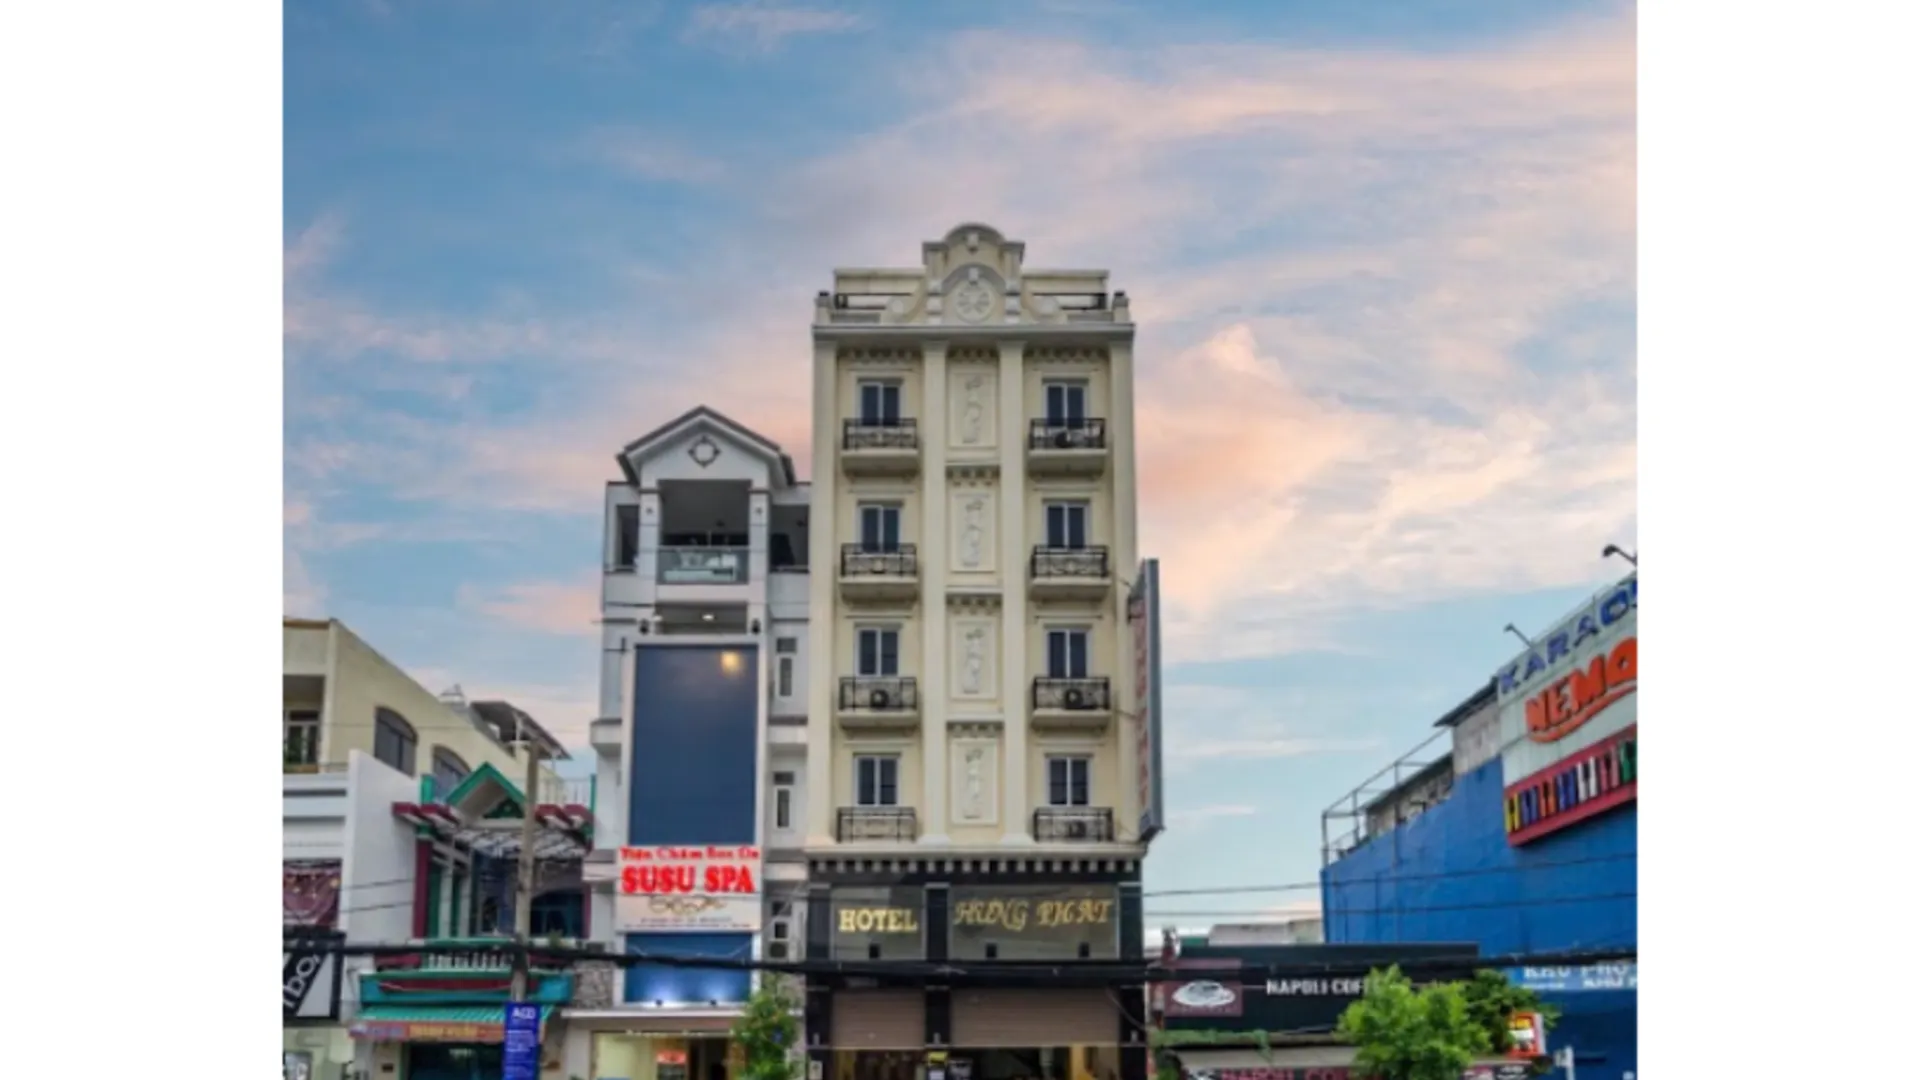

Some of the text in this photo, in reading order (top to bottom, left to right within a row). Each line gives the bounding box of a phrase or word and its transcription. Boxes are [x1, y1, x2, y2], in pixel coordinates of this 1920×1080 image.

[1525, 636, 1637, 732] NEMO
[621, 864, 756, 894] SUSU SPA
[838, 907, 919, 933] HOTEL
[1266, 977, 1328, 997] NAPOLI
